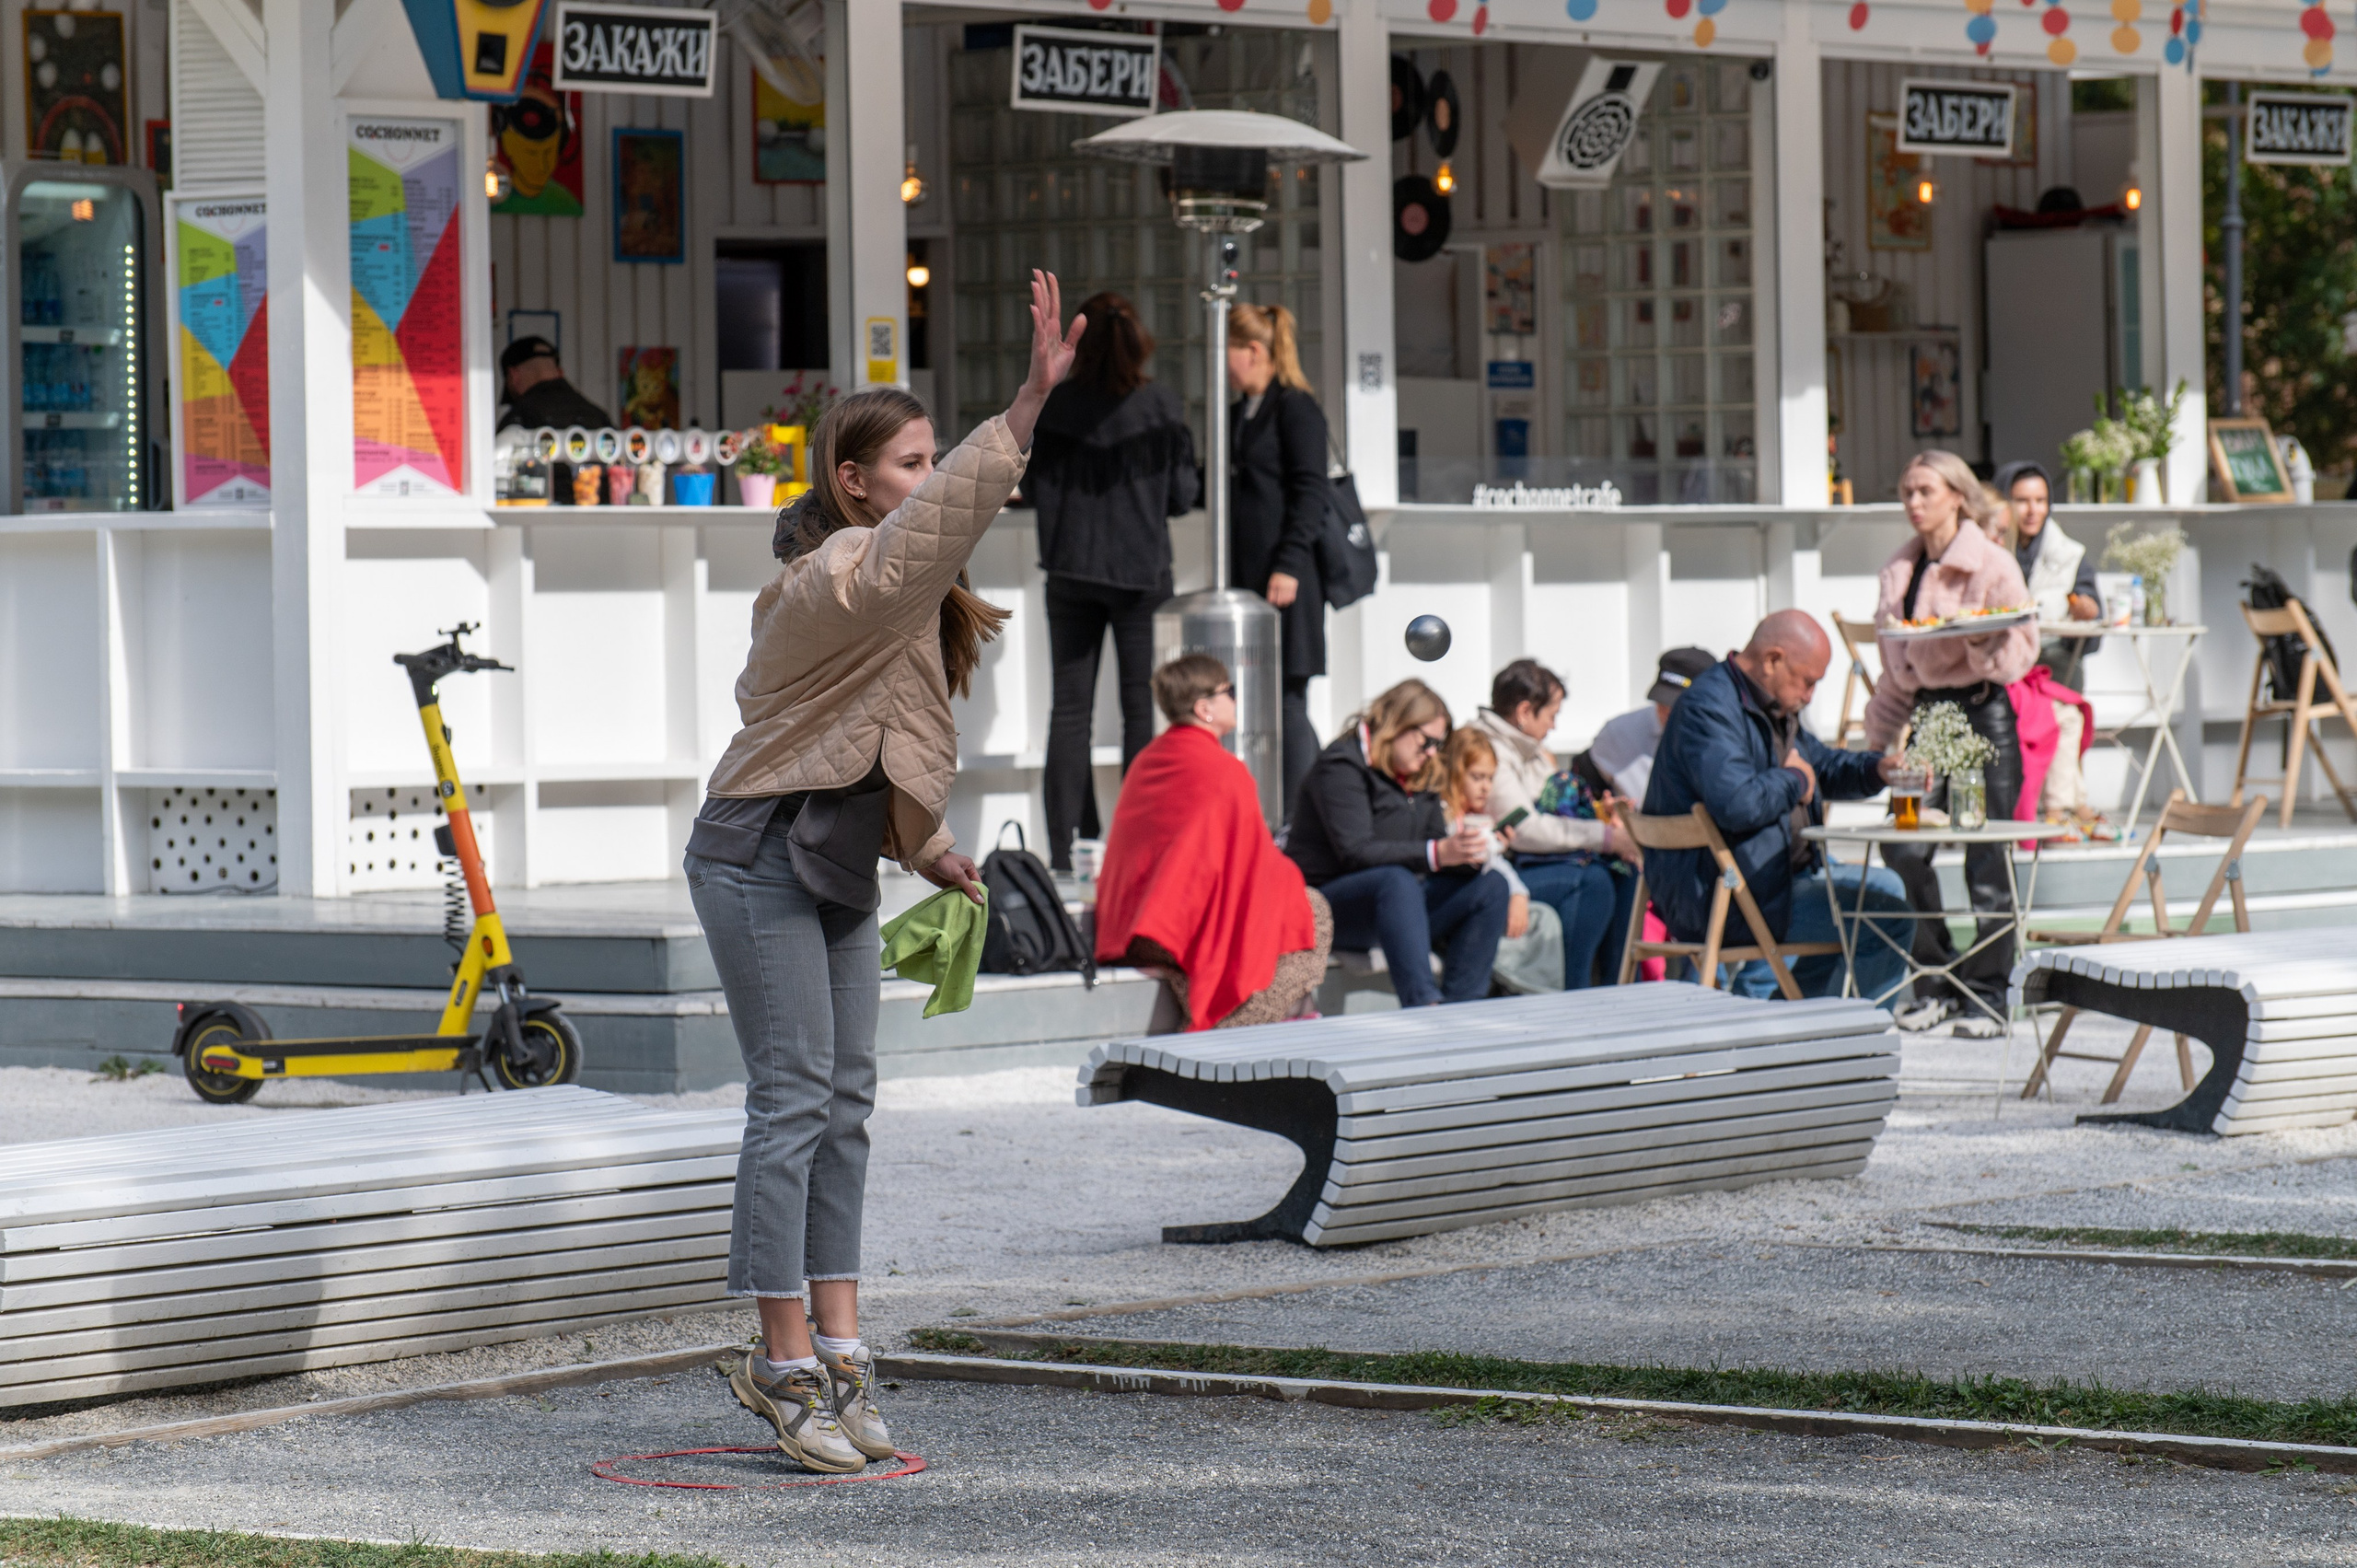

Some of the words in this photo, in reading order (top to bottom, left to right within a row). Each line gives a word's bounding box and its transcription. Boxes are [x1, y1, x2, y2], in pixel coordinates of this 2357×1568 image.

[563, 21, 708, 77] ЗАКАЖИ
[1022, 43, 1152, 98] ЗАБЕРИ
[355, 124, 440, 142] COCHONNET
[1907, 91, 2008, 140] ЗАБЕРИ
[2256, 105, 2346, 150] ЗАКАЖИ
[1473, 480, 1622, 508] #cochonnetcafe
